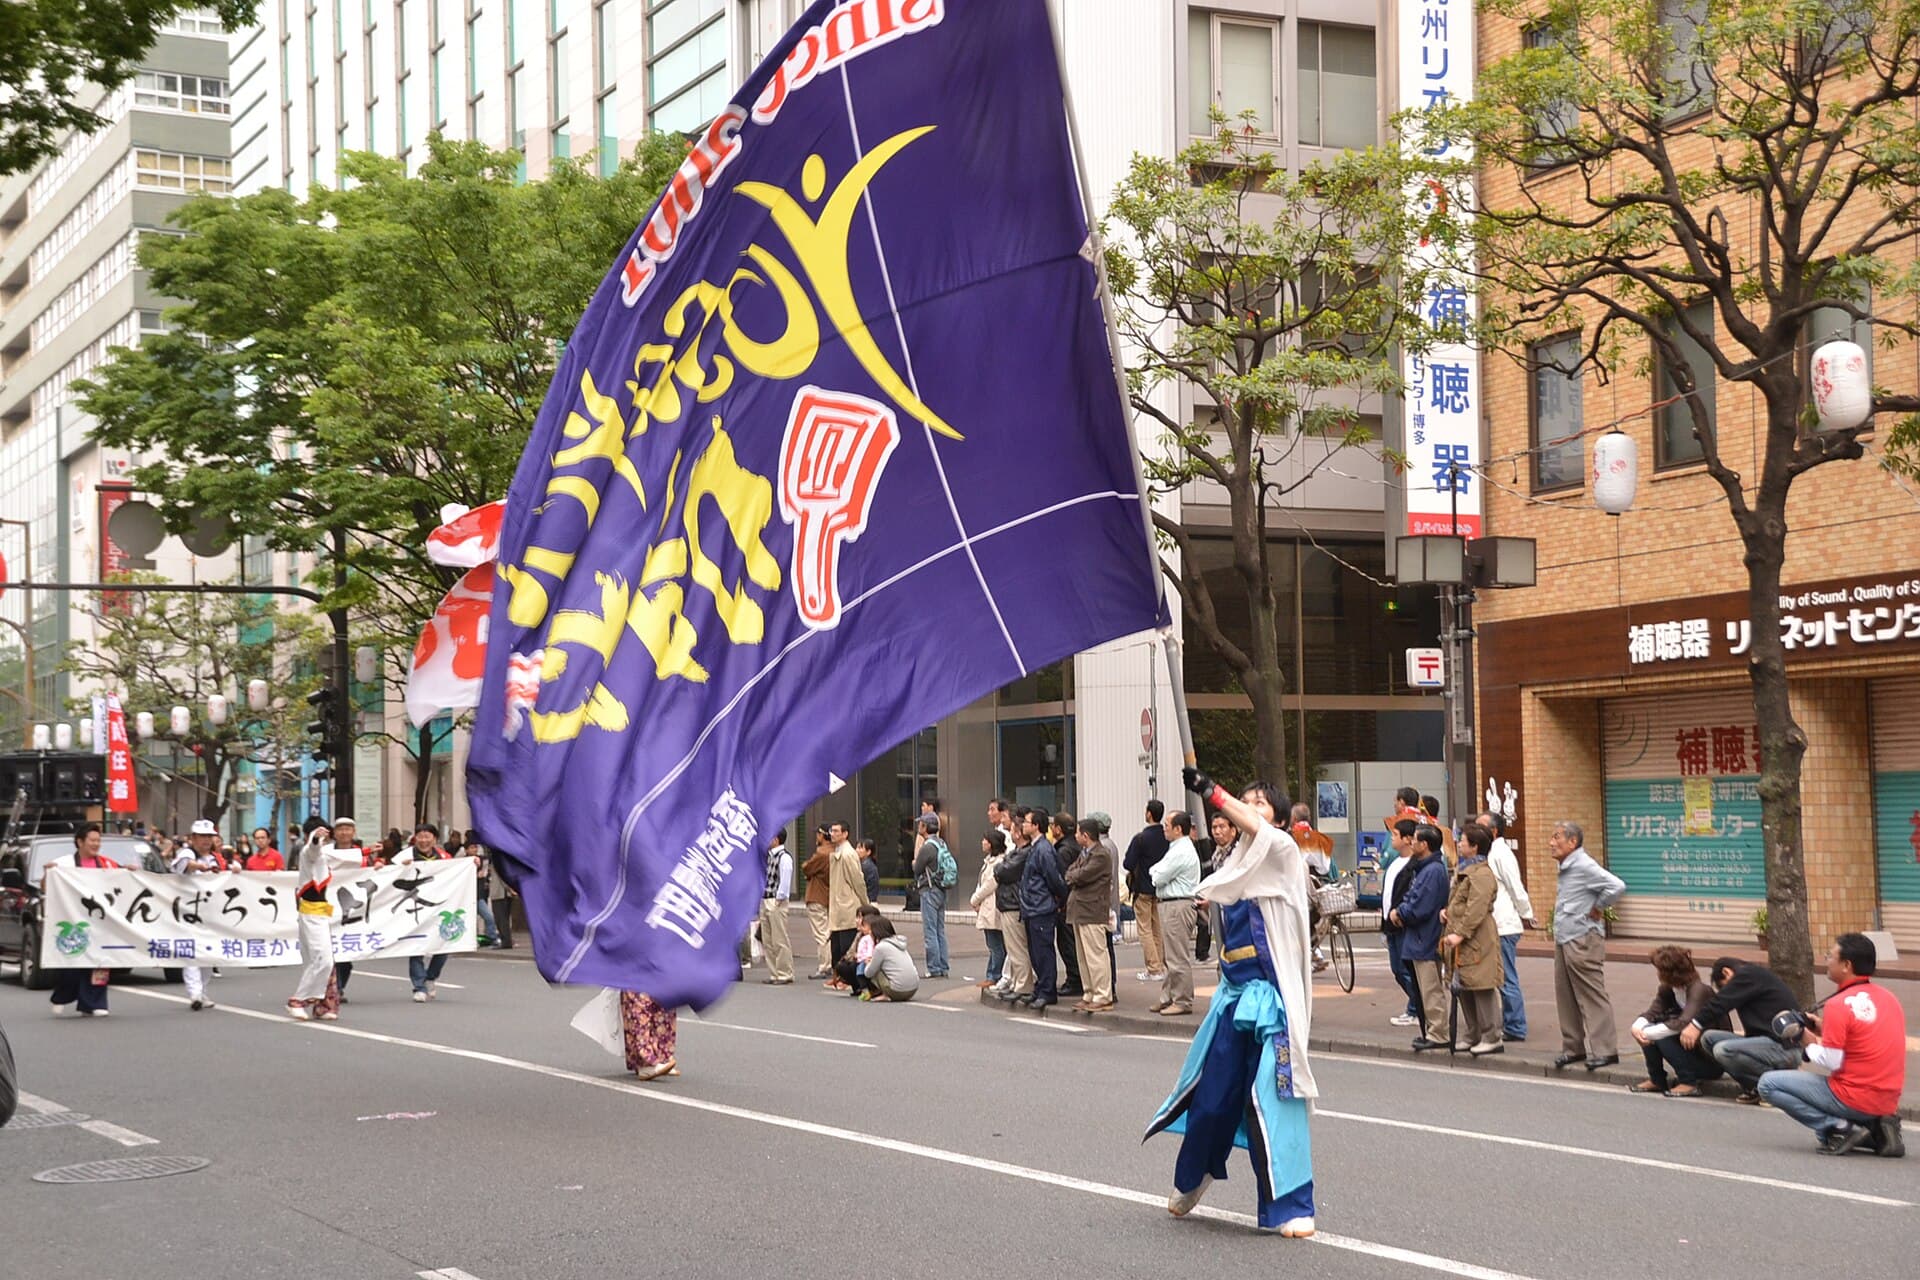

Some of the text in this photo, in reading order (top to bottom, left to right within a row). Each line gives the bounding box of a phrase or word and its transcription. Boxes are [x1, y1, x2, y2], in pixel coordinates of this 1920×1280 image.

[1798, 592, 1811, 606] of
[1853, 584, 1894, 602] Quality
[1896, 580, 1910, 596] of
[1628, 603, 1920, 664] 補聴器 リネットセンタ
[81, 885, 279, 925] がんばろう
